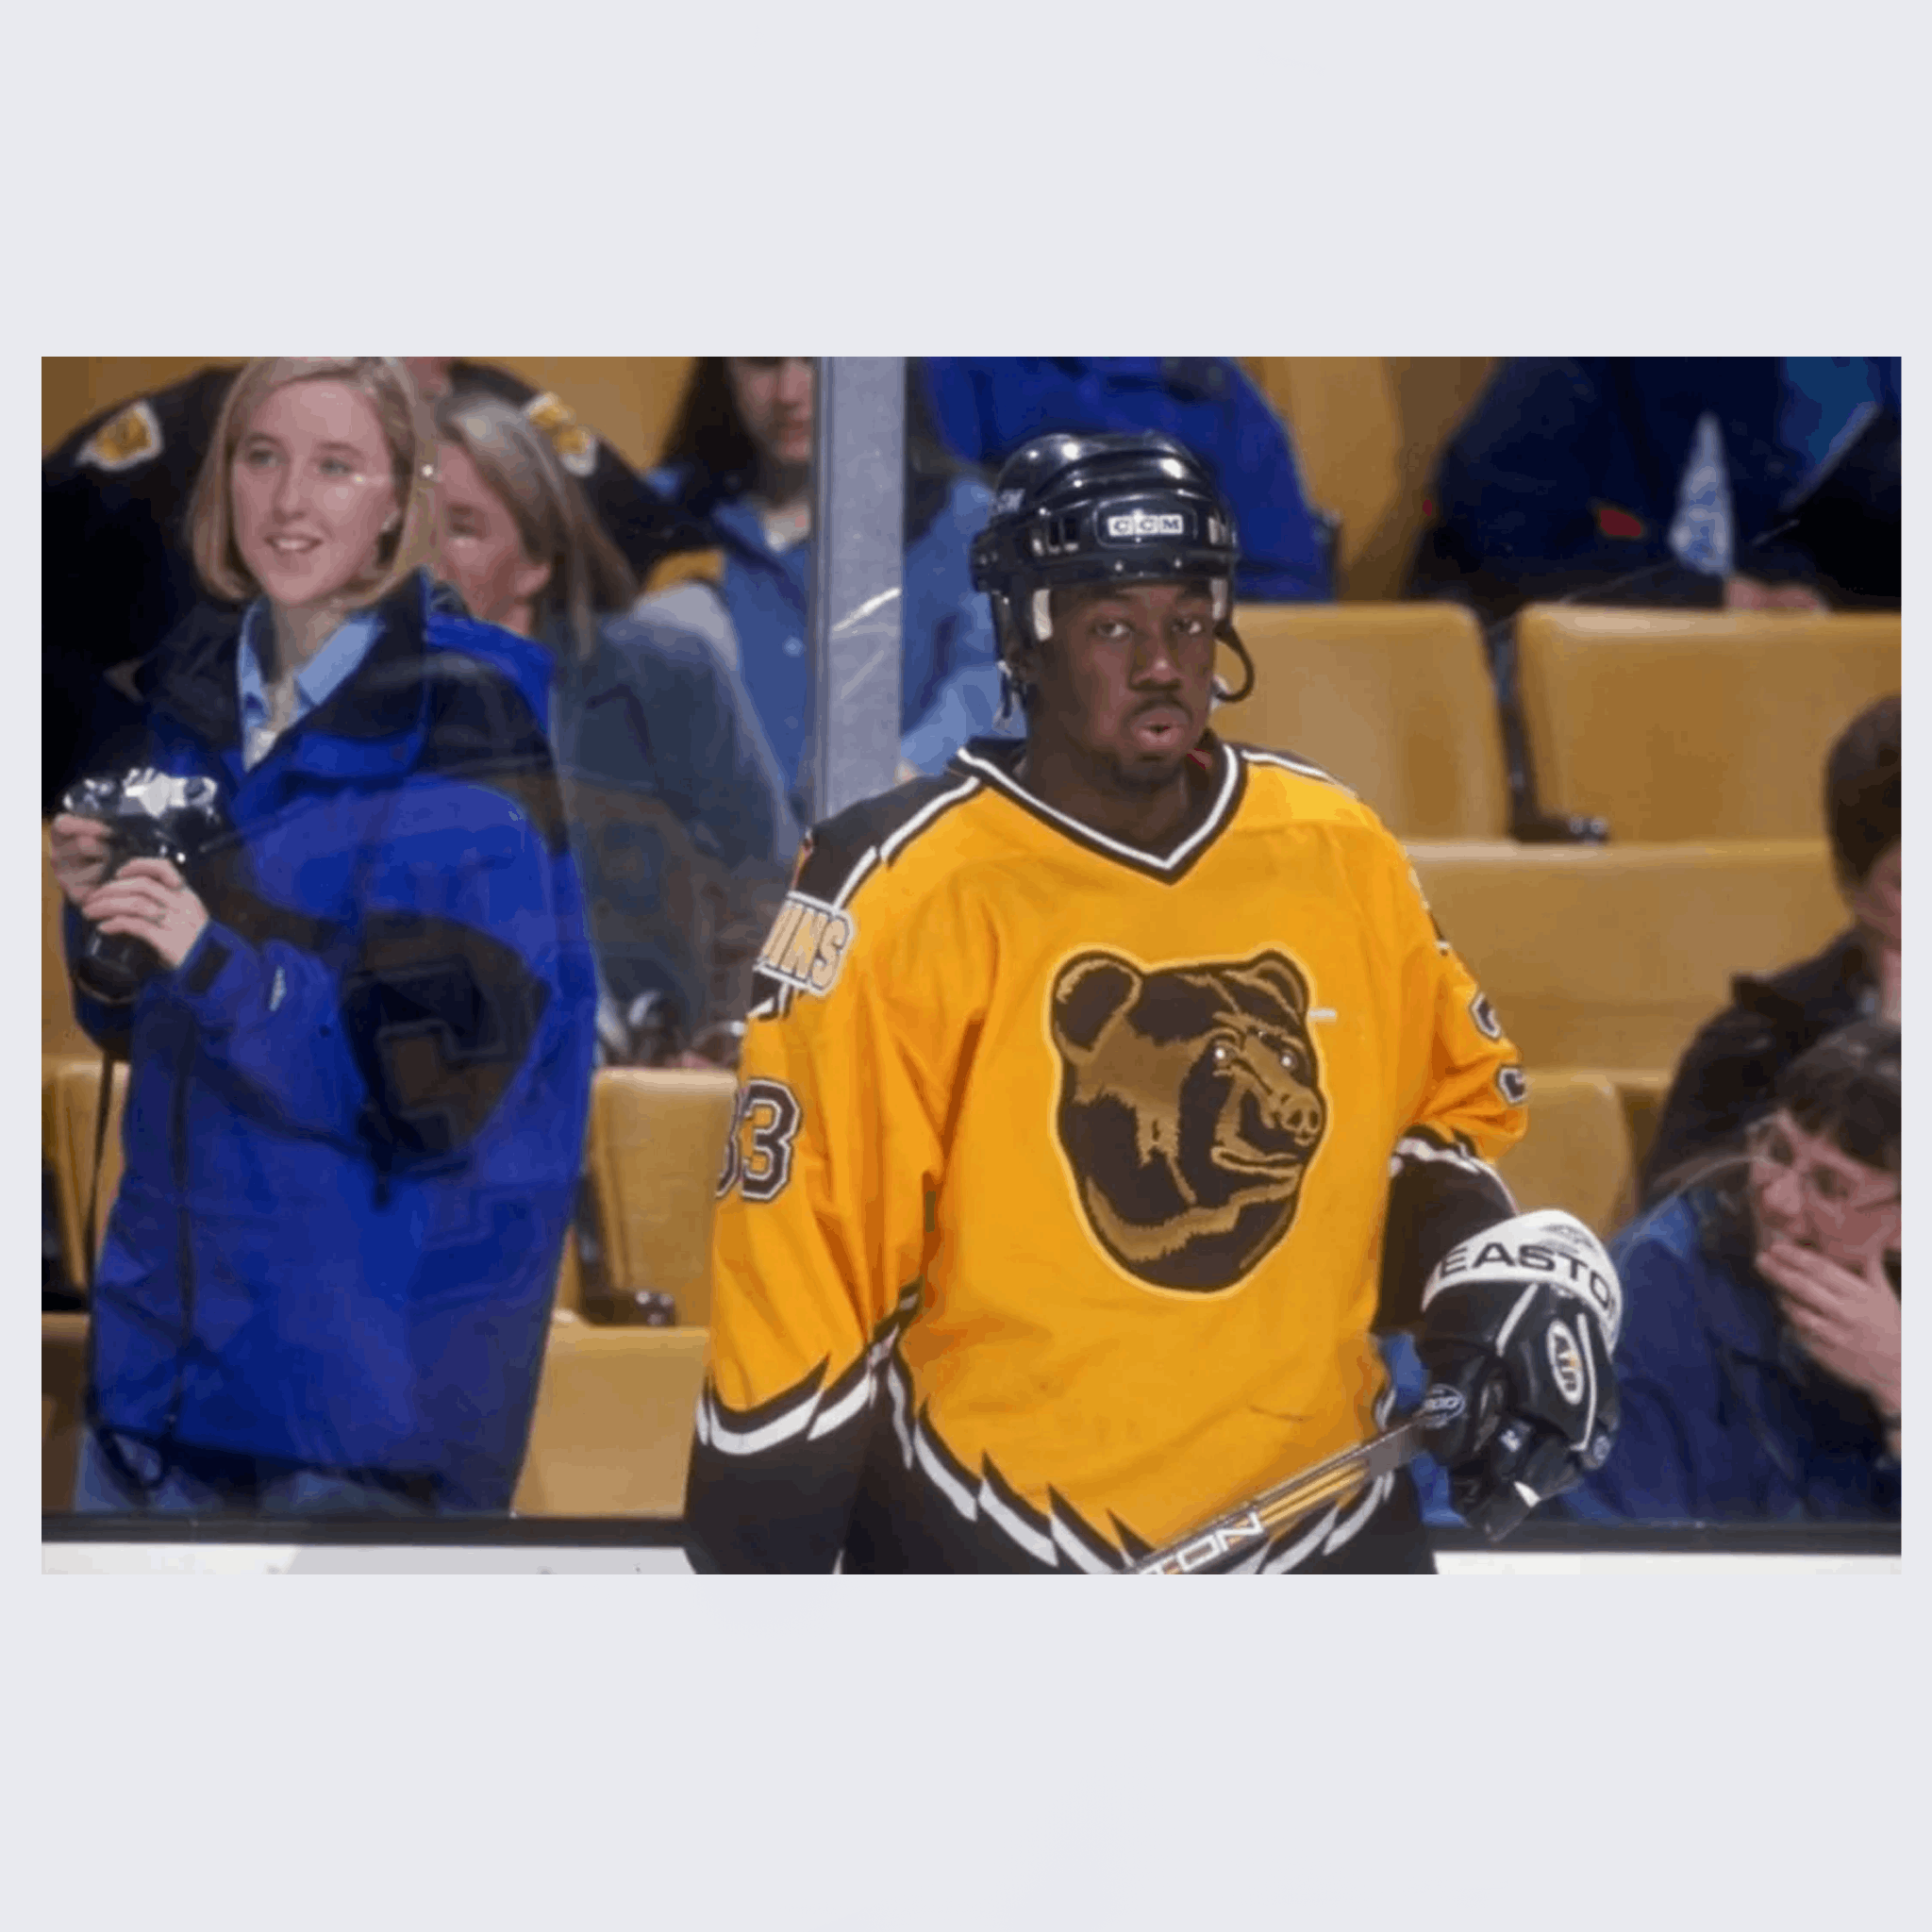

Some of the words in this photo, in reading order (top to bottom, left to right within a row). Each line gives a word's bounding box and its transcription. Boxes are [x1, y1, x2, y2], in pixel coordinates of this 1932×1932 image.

[1110, 515, 1182, 535] CCM
[717, 1079, 800, 1200] 3
[1441, 1241, 1613, 1312] EASTO
